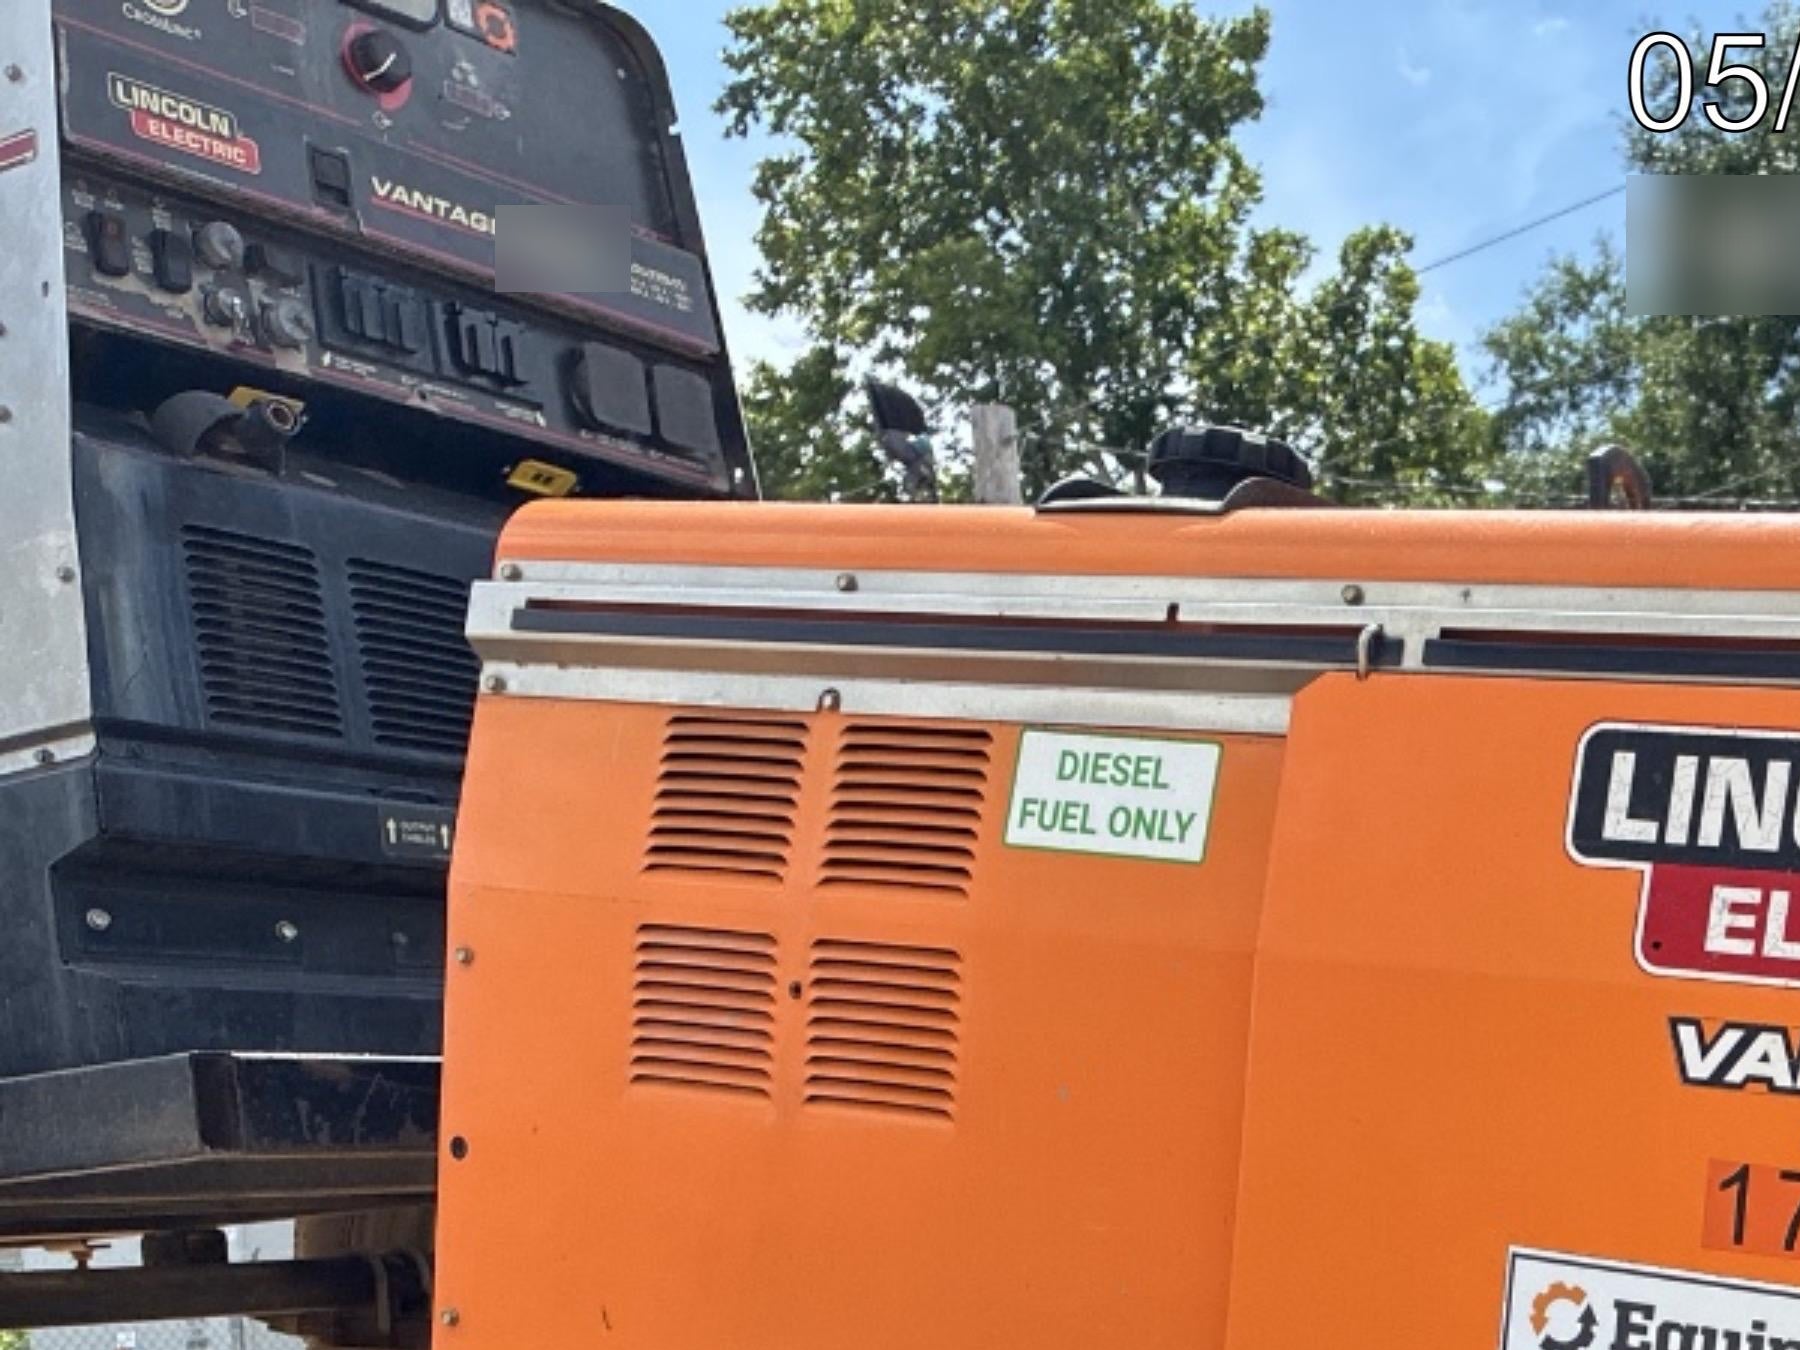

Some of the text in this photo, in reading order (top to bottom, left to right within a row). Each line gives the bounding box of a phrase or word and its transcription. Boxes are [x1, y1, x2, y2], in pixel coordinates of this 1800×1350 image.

[115, 79, 231, 138] LINCOLN
[148, 118, 248, 164] ELECTRIC
[370, 175, 496, 236] VANTAG
[1056, 748, 1170, 790] DIESEL
[1017, 797, 1198, 844] FUEL ONLY
